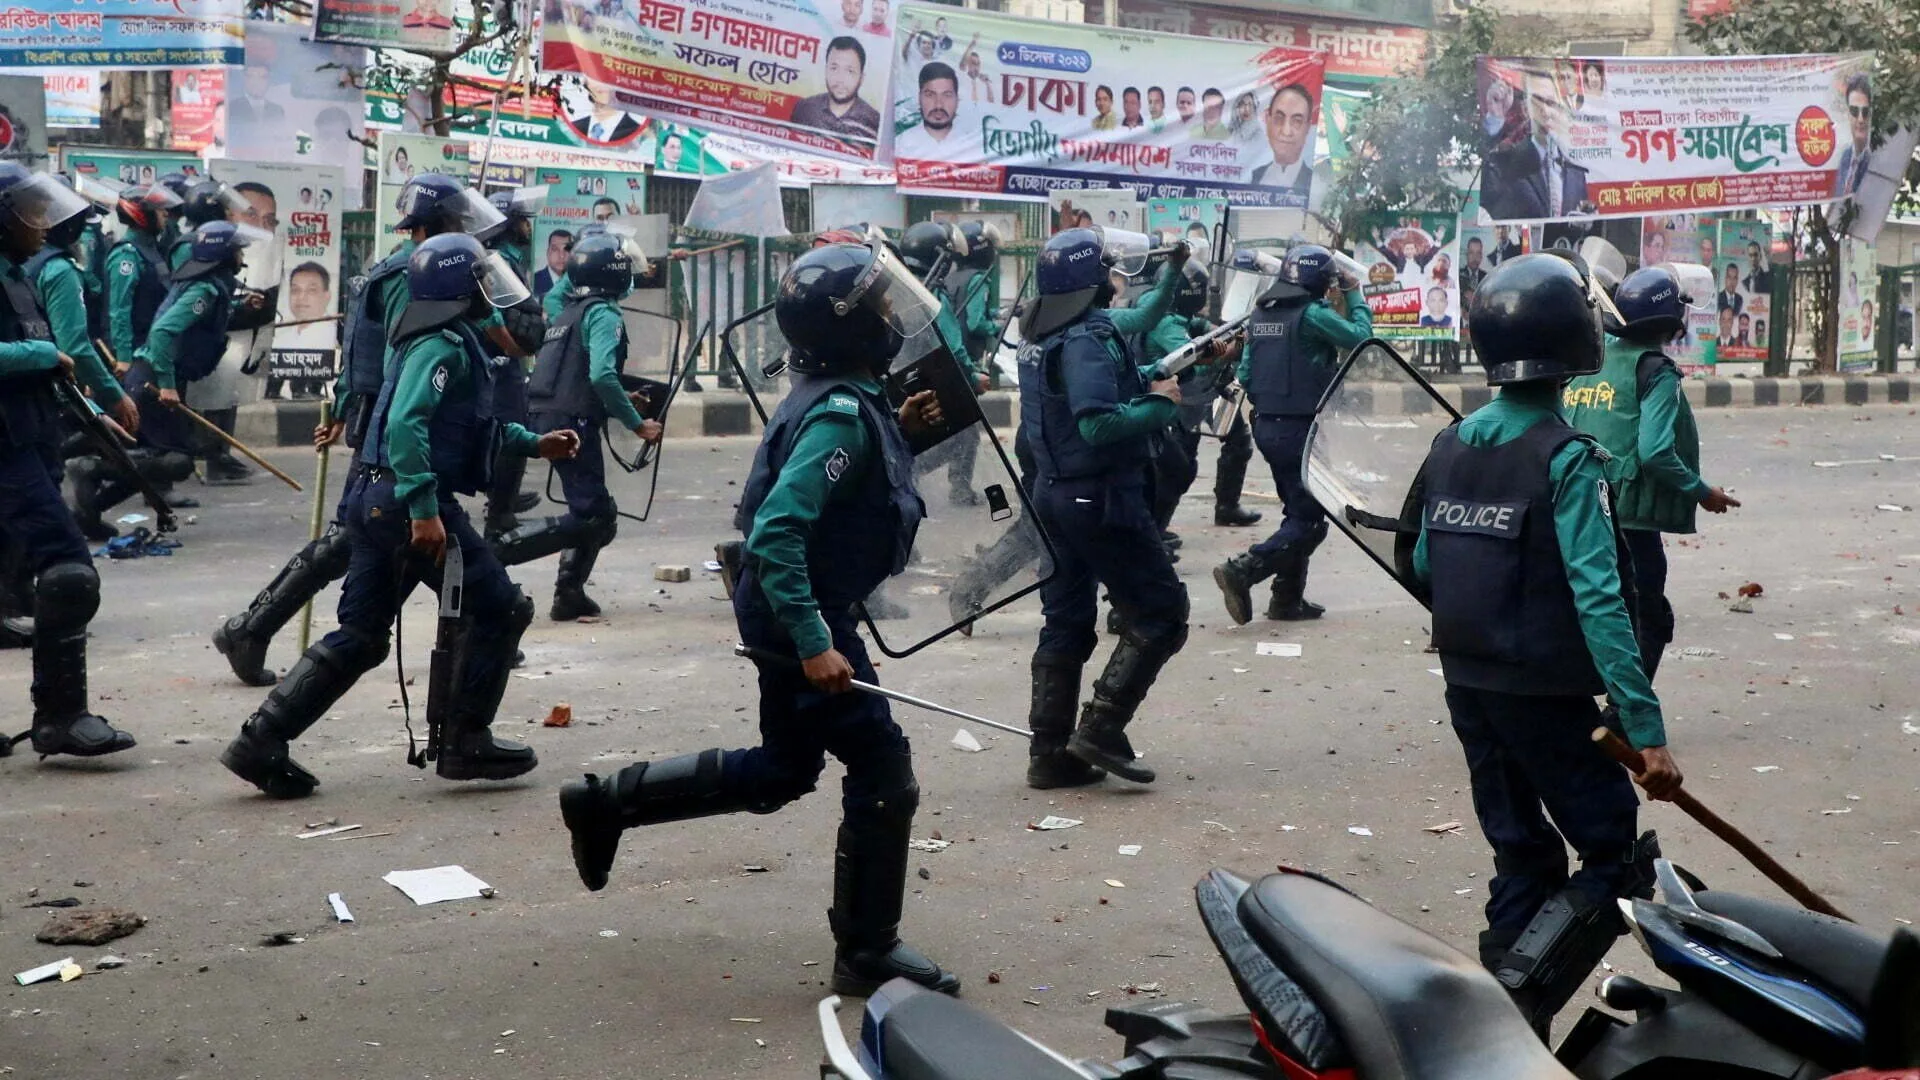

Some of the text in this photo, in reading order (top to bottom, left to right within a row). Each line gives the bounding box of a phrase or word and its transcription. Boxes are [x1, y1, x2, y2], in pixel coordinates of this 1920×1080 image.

[55, 12, 103, 31] আলম
[120, 22, 144, 34] যোগ
[638, 0, 685, 33] মহা
[690, 10, 820, 64] গণসমাবেশ
[672, 42, 802, 85] সফল হোক
[1001, 45, 1089, 70] ১০ ডিসেম্বর ২০২২
[1000, 73, 1089, 117] ঢাকা
[1664, 111, 1691, 124] ঢাকা
[1694, 107, 1741, 124] বিভাগীয়
[1799, 117, 1830, 135] সফল
[982, 114, 1058, 164] বিভাগীয়
[1621, 114, 1791, 173] গণ-সমাবেশ
[1568, 147, 1612, 160] বাংলাদেশ
[415, 185, 438, 198] POLICE
[1598, 186, 1622, 207] মোঃ
[1623, 181, 1665, 206] মনিরুল
[1667, 184, 1688, 203] হক
[291, 211, 329, 233] দেশ
[205, 236, 224, 245] POLICE
[438, 254, 467, 269] POLICE
[1069, 247, 1095, 263] POLICE
[1299, 259, 1319, 267] POLICE
[1650, 287, 1672, 303] POLICE
[1254, 325, 1281, 335] POLICE
[1432, 500, 1515, 531] POLICE
[1684, 941, 1730, 966] 150
